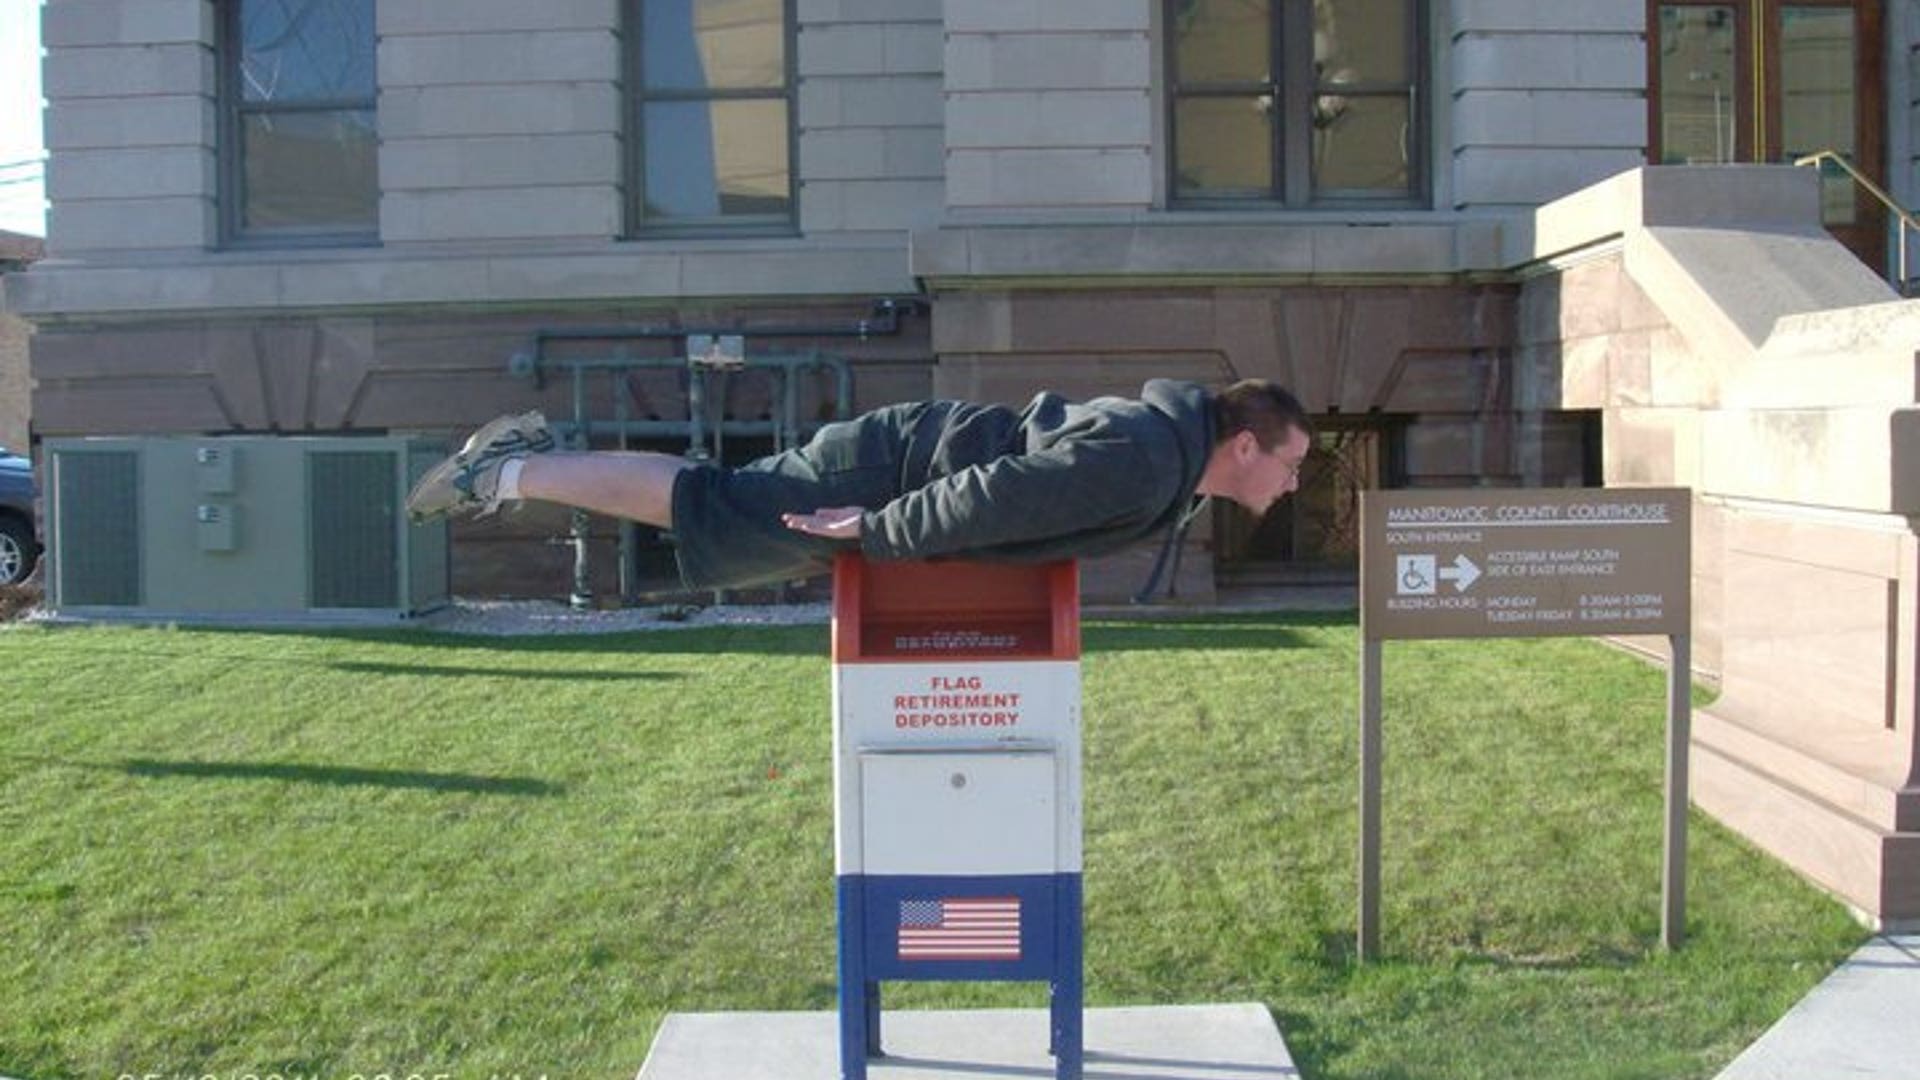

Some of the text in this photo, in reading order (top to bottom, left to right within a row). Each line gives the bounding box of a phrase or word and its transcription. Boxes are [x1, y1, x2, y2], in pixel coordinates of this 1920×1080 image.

[1496, 505, 1559, 520] COUNTY
[1567, 503, 1669, 519] COURTHOUSE
[1425, 531, 1482, 542] ENTRANCE
[930, 676, 983, 691] FLAG
[894, 694, 1021, 709] RETIREMENT
[895, 712, 1020, 728] DEPOSITORY
